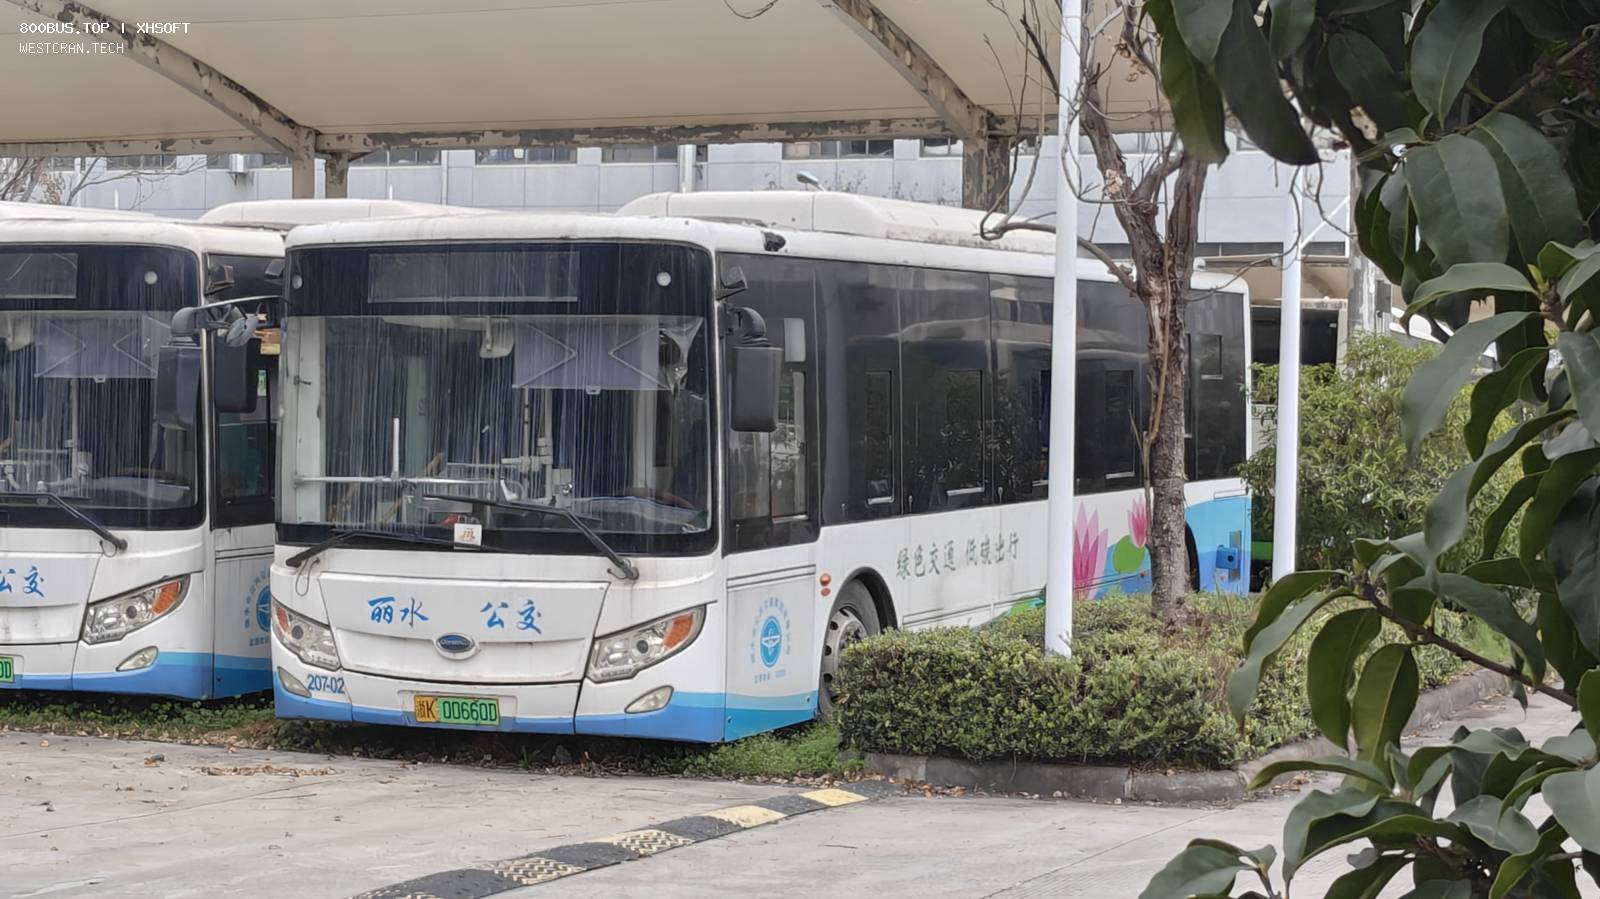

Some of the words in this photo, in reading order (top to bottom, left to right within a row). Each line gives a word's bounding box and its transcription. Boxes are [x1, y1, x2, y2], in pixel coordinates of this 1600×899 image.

[896, 539, 956, 580] 绿色交通
[966, 532, 1019, 566] 低碳出行
[368, 595, 429, 629] 丽水
[481, 599, 542, 634] 公交
[307, 674, 345, 694] 207-02
